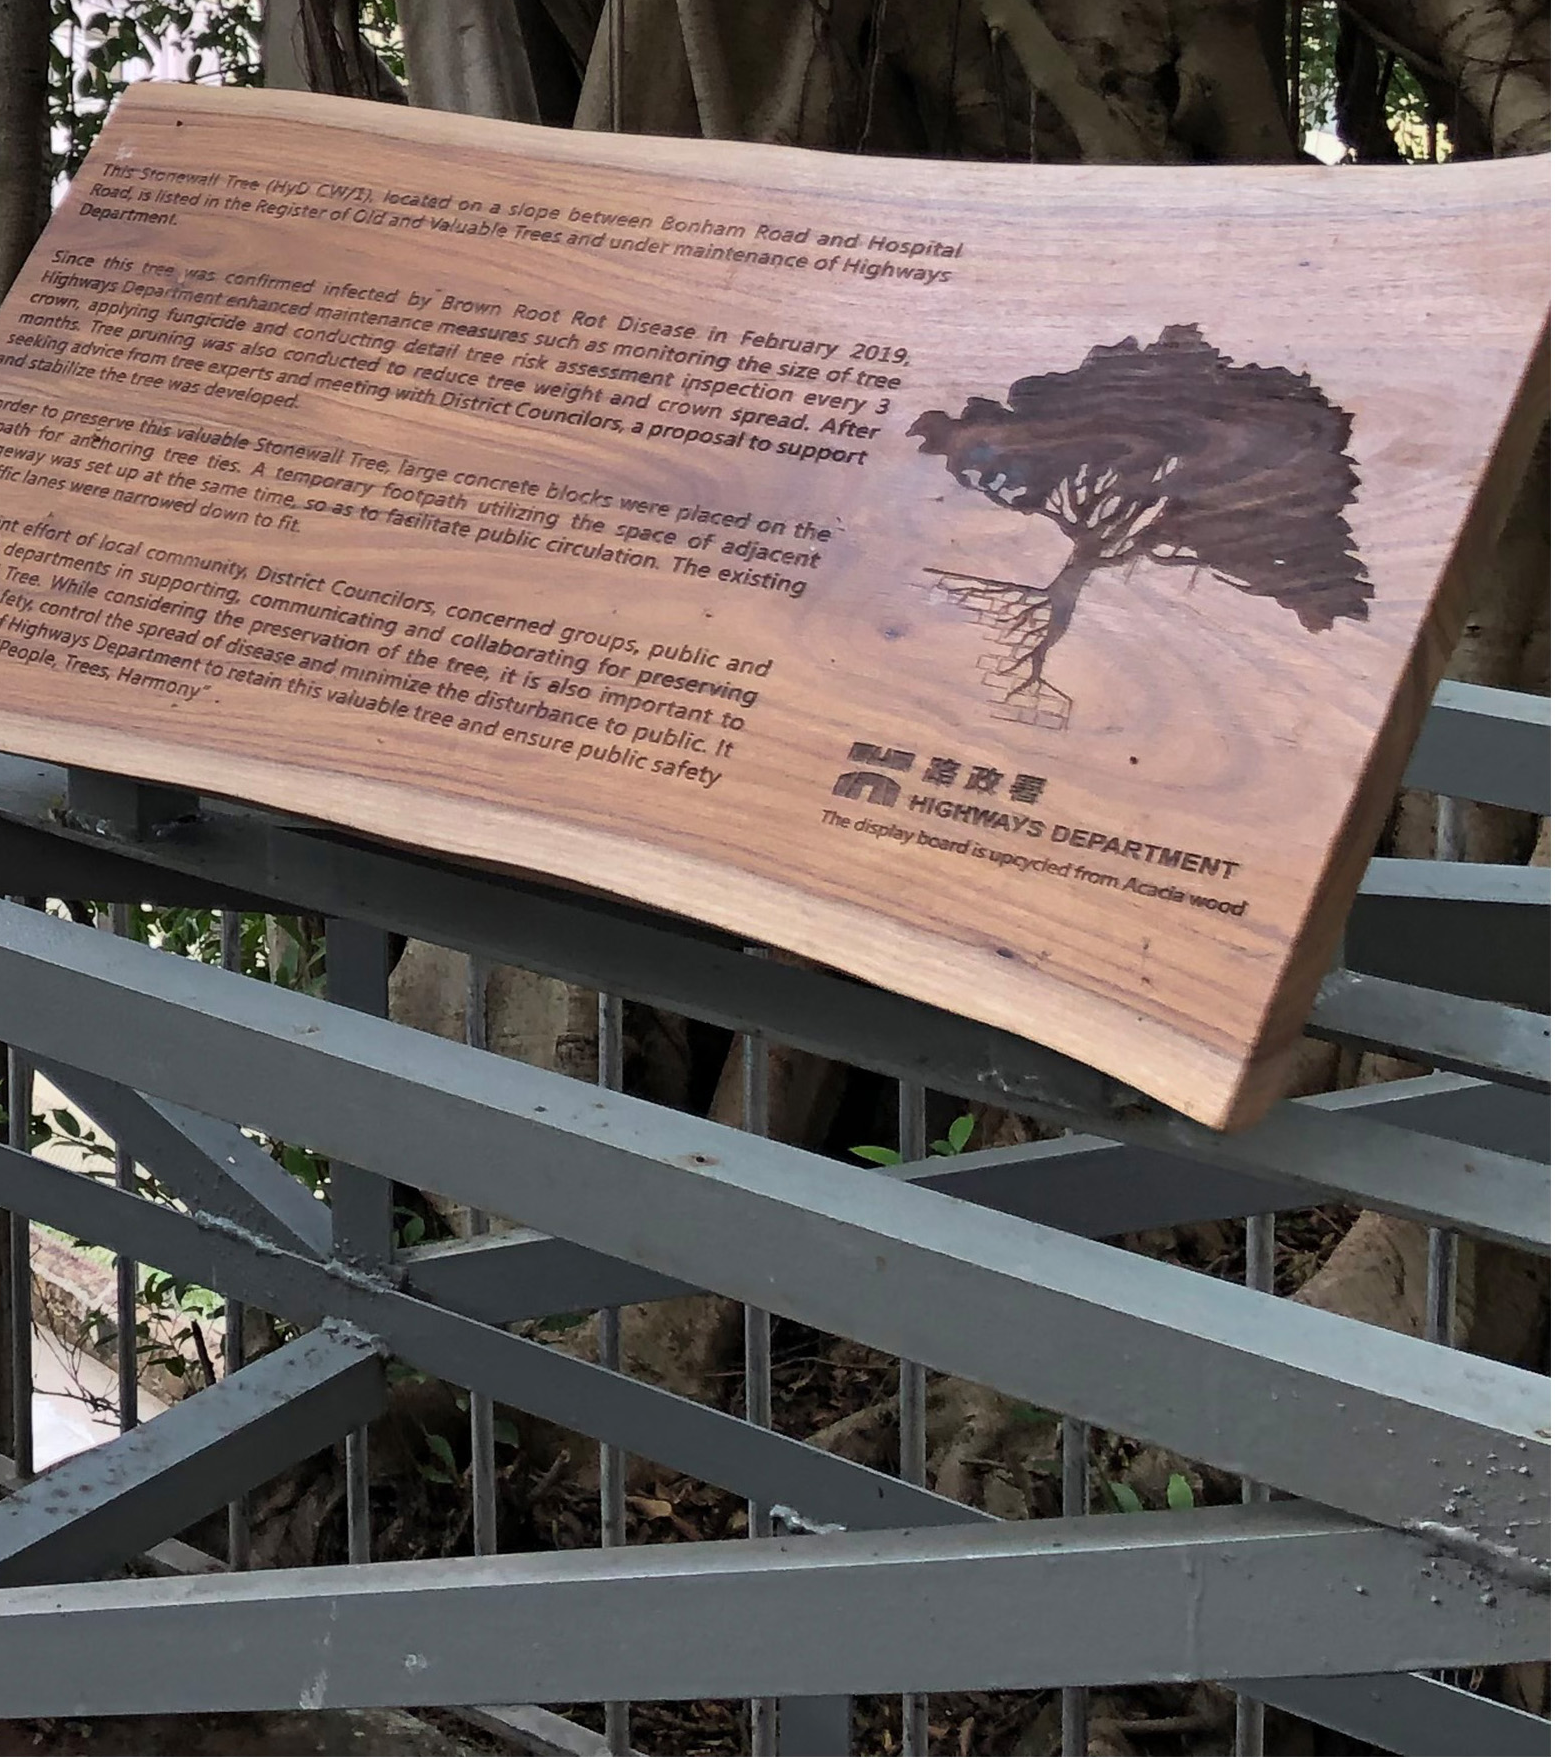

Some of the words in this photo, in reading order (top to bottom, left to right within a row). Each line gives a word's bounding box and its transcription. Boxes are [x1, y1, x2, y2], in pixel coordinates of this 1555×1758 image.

[79, 204, 176, 224] Department.
[90, 184, 133, 200] Road,
[137, 189, 152, 200] is
[155, 190, 201, 205] listed
[203, 195, 220, 207] in
[223, 198, 251, 210] the
[255, 201, 326, 218] Register
[328, 209, 349, 220] of
[351, 210, 386, 224] Old
[388, 216, 425, 228] and
[428, 218, 507, 237] Valuable
[511, 227, 562, 242] Trees
[566, 235, 605, 247] and
[608, 239, 667, 254] under
[673, 247, 808, 268] maintenance
[812, 259, 837, 272] of
[841, 261, 951, 286] Highways
[102, 164, 135, 177] This
[140, 168, 220, 185] Stonewall
[226, 176, 260, 189] Tree
[265, 179, 311, 196] (HyD
[383, 191, 453, 208] located
[457, 201, 483, 211] on
[489, 204, 502, 212] a
[509, 204, 561, 221] slope
[568, 208, 653, 227] between
[661, 218, 746, 237] Bonham
[755, 227, 810, 243] Road
[816, 235, 860, 248] and
[867, 238, 965, 259] Hospital
[28, 296, 78, 311] crown,
[88, 303, 159, 323] applying
[166, 310, 246, 331] fungicide
[251, 324, 288, 336] and
[293, 329, 396, 353] conducting
[403, 340, 459, 358] detail
[465, 349, 504, 364] tree
[512, 355, 548, 370] risk
[555, 363, 674, 386] assessment
[681, 375, 794, 401] inspection
[803, 394, 866, 415] every
[876, 400, 891, 414] 3
[41, 272, 118, 293] Highways
[121, 282, 223, 304] Department
[225, 297, 312, 315] enhanced
[315, 309, 433, 331] maintenance
[437, 324, 529, 343] measures
[534, 336, 581, 349] such
[584, 342, 607, 353] as
[613, 346, 730, 372] monitoring
[735, 358, 772, 373] the
[778, 364, 819, 379] size
[824, 370, 850, 383] of
[855, 373, 902, 390] tree
[7, 336, 67, 355] seeking
[71, 343, 123, 359] advice
[126, 349, 167, 365] from
[170, 356, 204, 370] tree
[207, 364, 273, 380] experts
[276, 373, 313, 385] and
[314, 378, 391, 400] meeting
[394, 388, 438, 403] with
[440, 392, 512, 413] District
[514, 402, 625, 432] Councilors,
[631, 422, 644, 432] a
[647, 424, 746, 446] proposal
[747, 436, 773, 450] to
[777, 442, 868, 463] support
[22, 472, 66, 489] lanes
[69, 483, 110, 497] were
[113, 490, 198, 512] narrowed
[199, 502, 250, 521] down
[253, 512, 273, 526] to
[278, 516, 300, 531] fit.
[37, 428, 63, 442] for
[70, 436, 155, 460] anchoring
[163, 449, 198, 465] tree
[206, 457, 240, 472] ties.
[251, 463, 267, 476] A
[274, 468, 373, 497] temporary
[382, 485, 469, 509] footpath
[477, 503, 559, 528] utilizing
[569, 516, 606, 532] the
[616, 526, 677, 544] space
[686, 536, 712, 550] of
[722, 542, 821, 567] adjacent
[2, 544, 110, 574] departments
[115, 566, 133, 580] in
[138, 575, 238, 604] supporting,
[248, 597, 398, 636] communicating
[403, 627, 444, 642] and
[449, 636, 589, 674] collaborating
[596, 661, 629, 679] for
[634, 672, 759, 708] preserving
[22, 524, 72, 541] effort
[75, 533, 96, 546] of
[99, 536, 143, 555] local
[146, 549, 246, 577] community,
[256, 566, 326, 590] District
[330, 580, 437, 613] Councilors,
[446, 605, 557, 633] concerned
[560, 627, 640, 652] groups,
[649, 643, 719, 664] public
[726, 658, 774, 674] and
[63, 655, 111, 679] Trees,
[922, 756, 1048, 805] 路政署
[821, 809, 851, 829] The
[854, 818, 915, 845] display
[916, 830, 972, 855] board
[972, 843, 989, 859] is
[989, 849, 1074, 879] upcycled
[1074, 864, 1120, 890] from
[1120, 876, 1188, 905] Acacia
[1189, 892, 1248, 918] wood
[909, 794, 1049, 839] HIGHWAYS
[1051, 825, 1241, 880] DEPARTMENT
